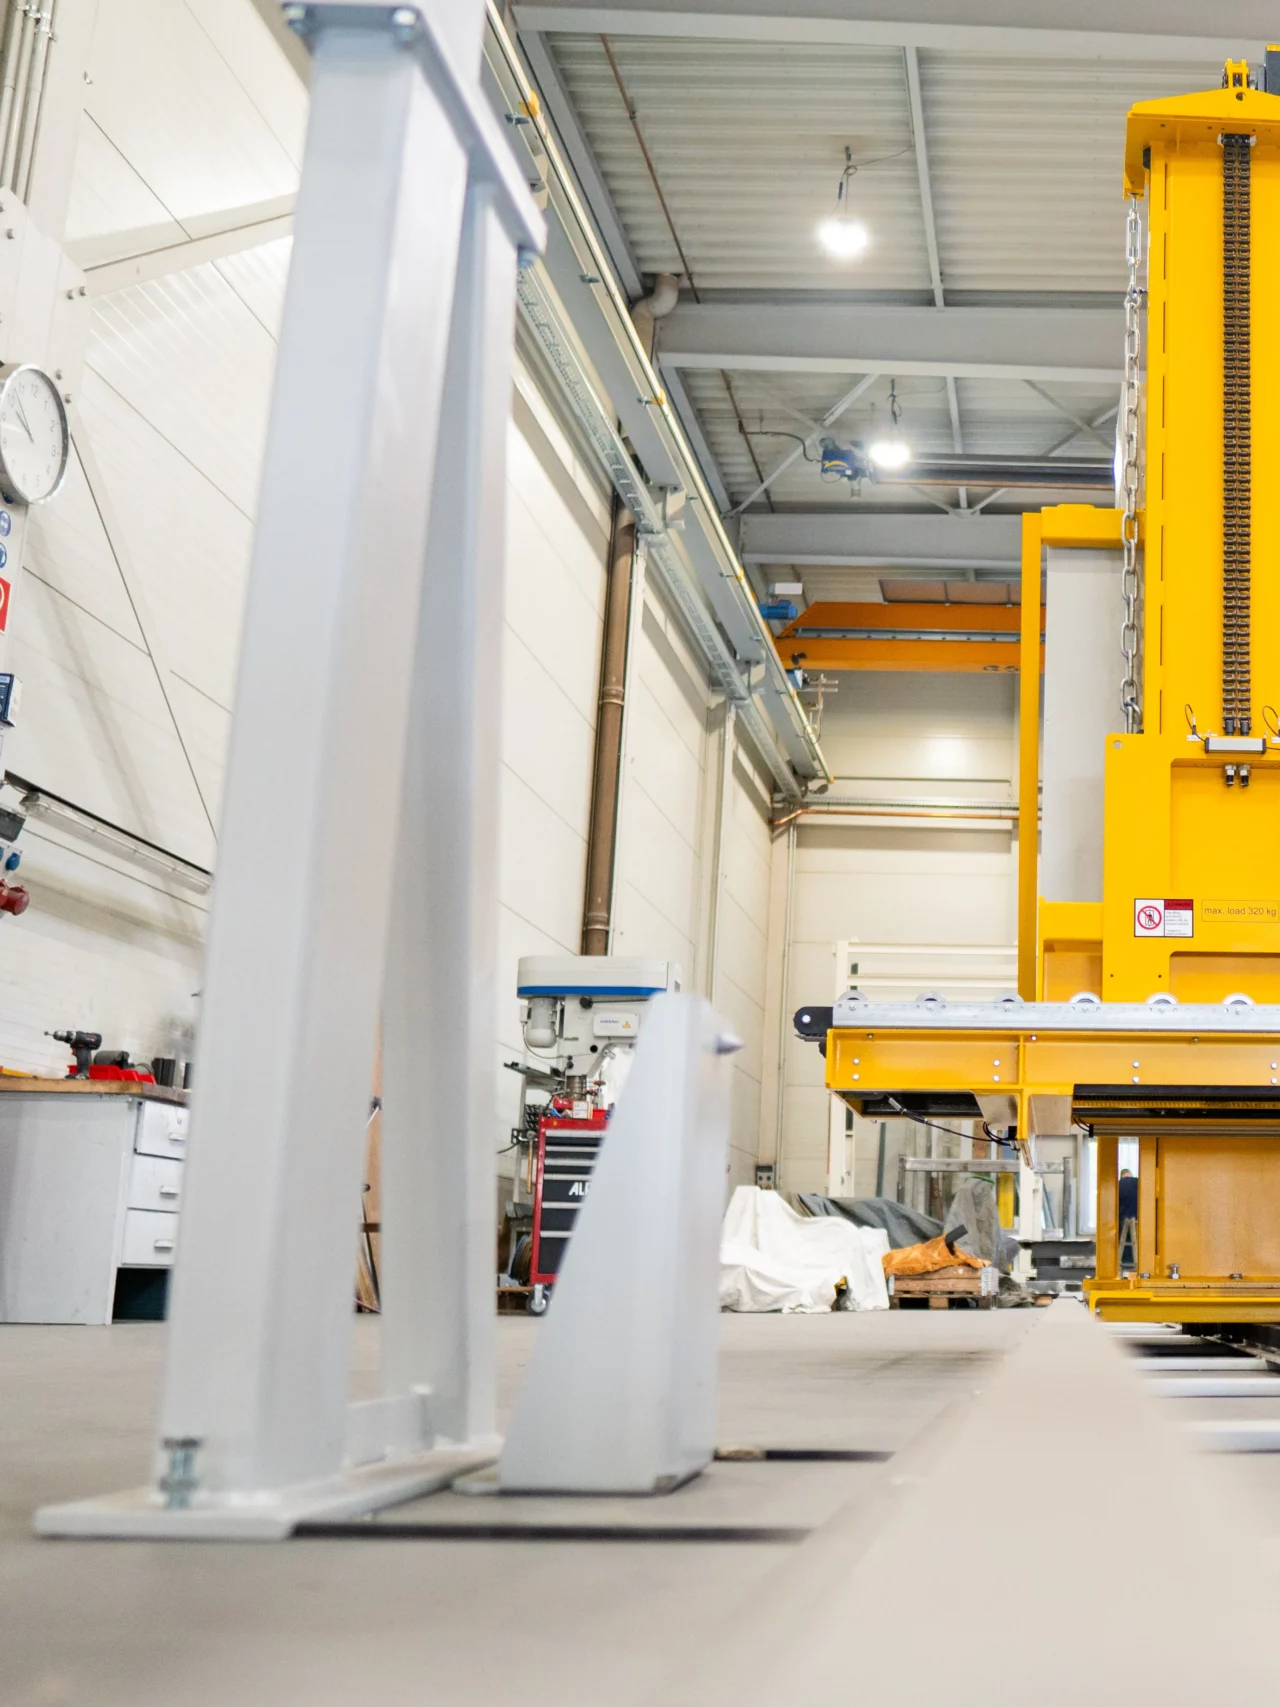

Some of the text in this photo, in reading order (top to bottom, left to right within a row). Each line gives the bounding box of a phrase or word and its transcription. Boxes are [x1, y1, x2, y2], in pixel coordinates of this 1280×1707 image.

[1204, 906, 1277, 918] max. load 320 kg
